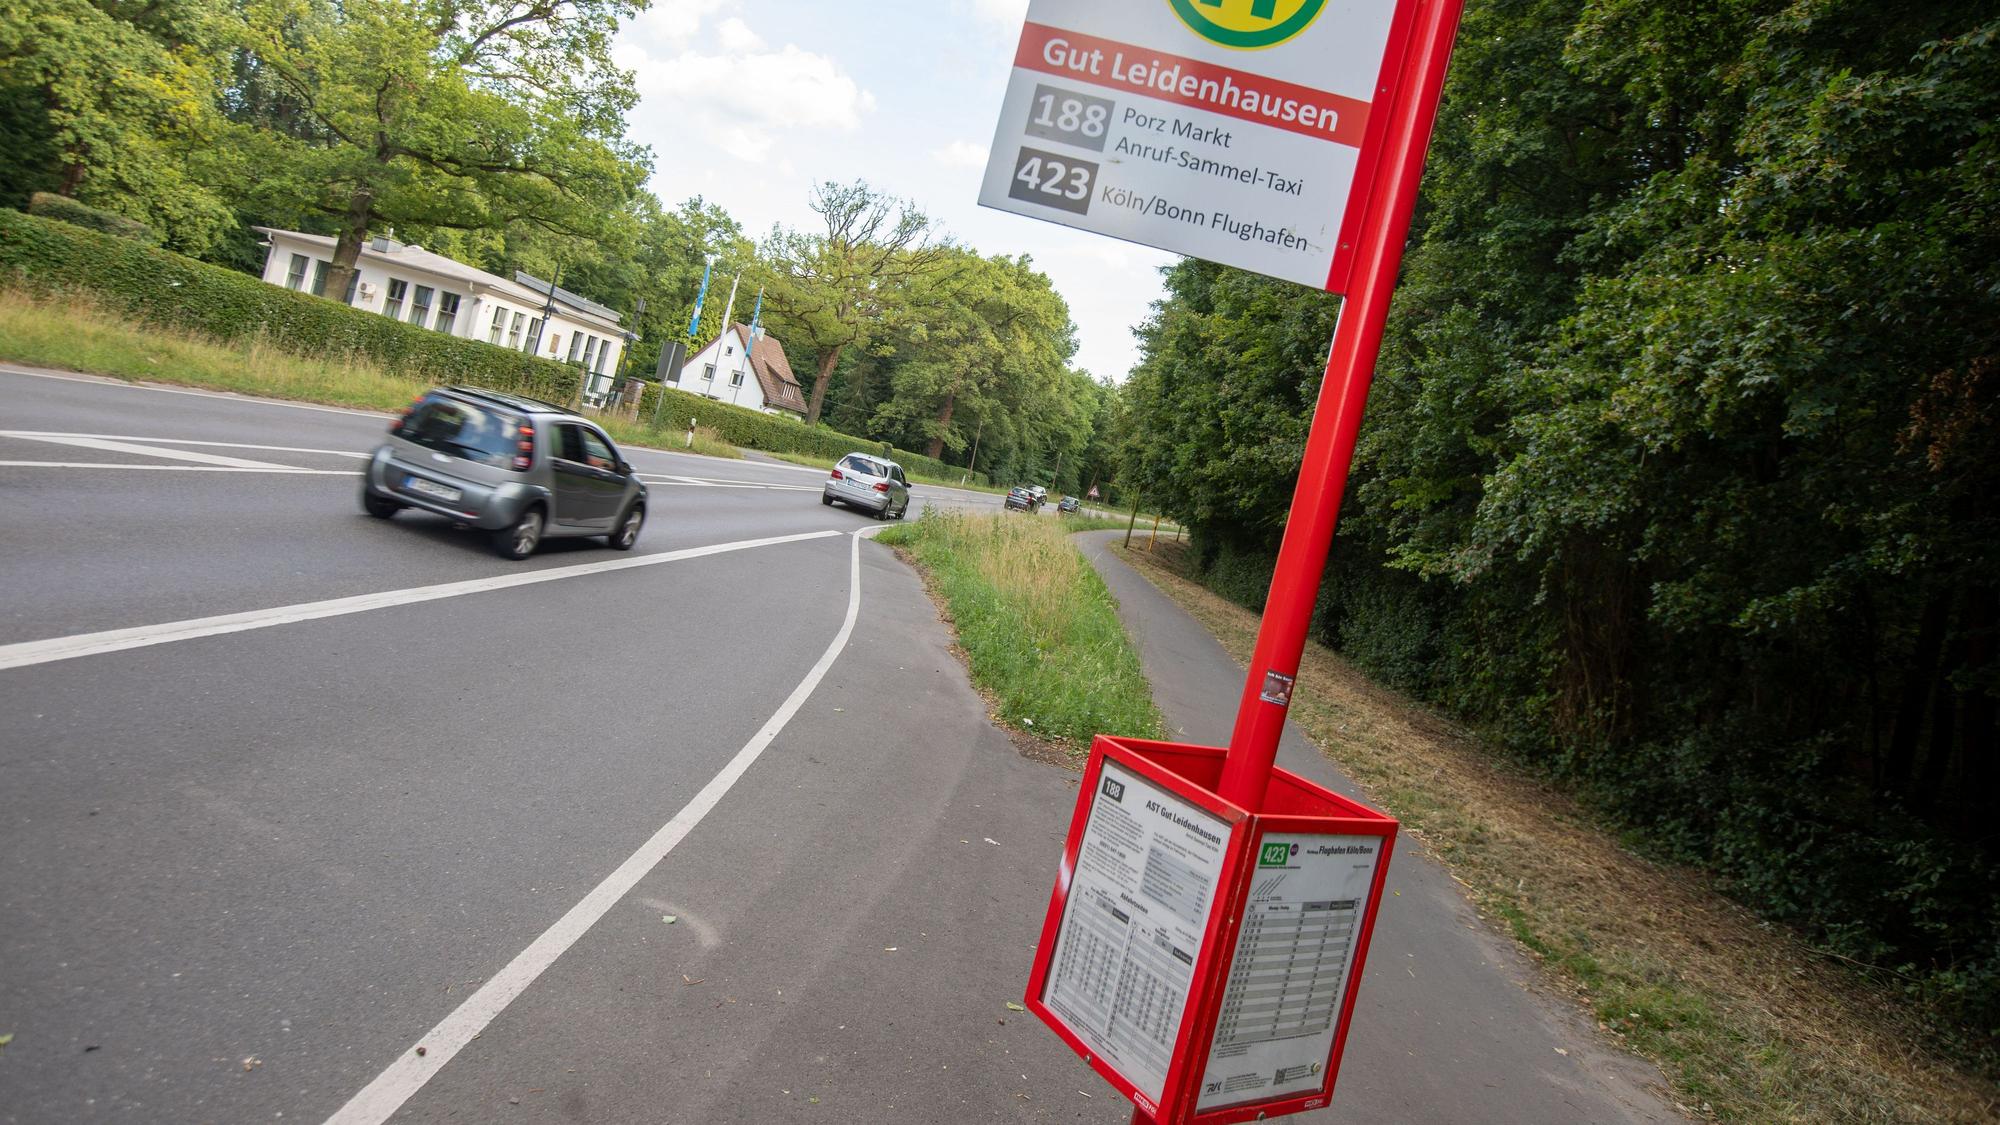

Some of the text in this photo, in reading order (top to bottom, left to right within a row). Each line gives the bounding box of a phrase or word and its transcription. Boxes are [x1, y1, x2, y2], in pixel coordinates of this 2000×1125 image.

[1043, 38, 1339, 132] Gut Leidenhausen
[1033, 94, 1106, 139] 188
[1122, 107, 1232, 149] Porz Markt
[1016, 157, 1090, 201] 423
[1115, 136, 1304, 196] Anruf-Sammel-Taxi
[1101, 186, 1308, 252] Köln/Bonn Flughafen
[1104, 780, 1121, 798] 188
[1145, 800, 1160, 813] AST
[1160, 807, 1172, 820] Gut
[1173, 813, 1221, 845] Leidenhausen
[1263, 846, 1286, 863] 423
